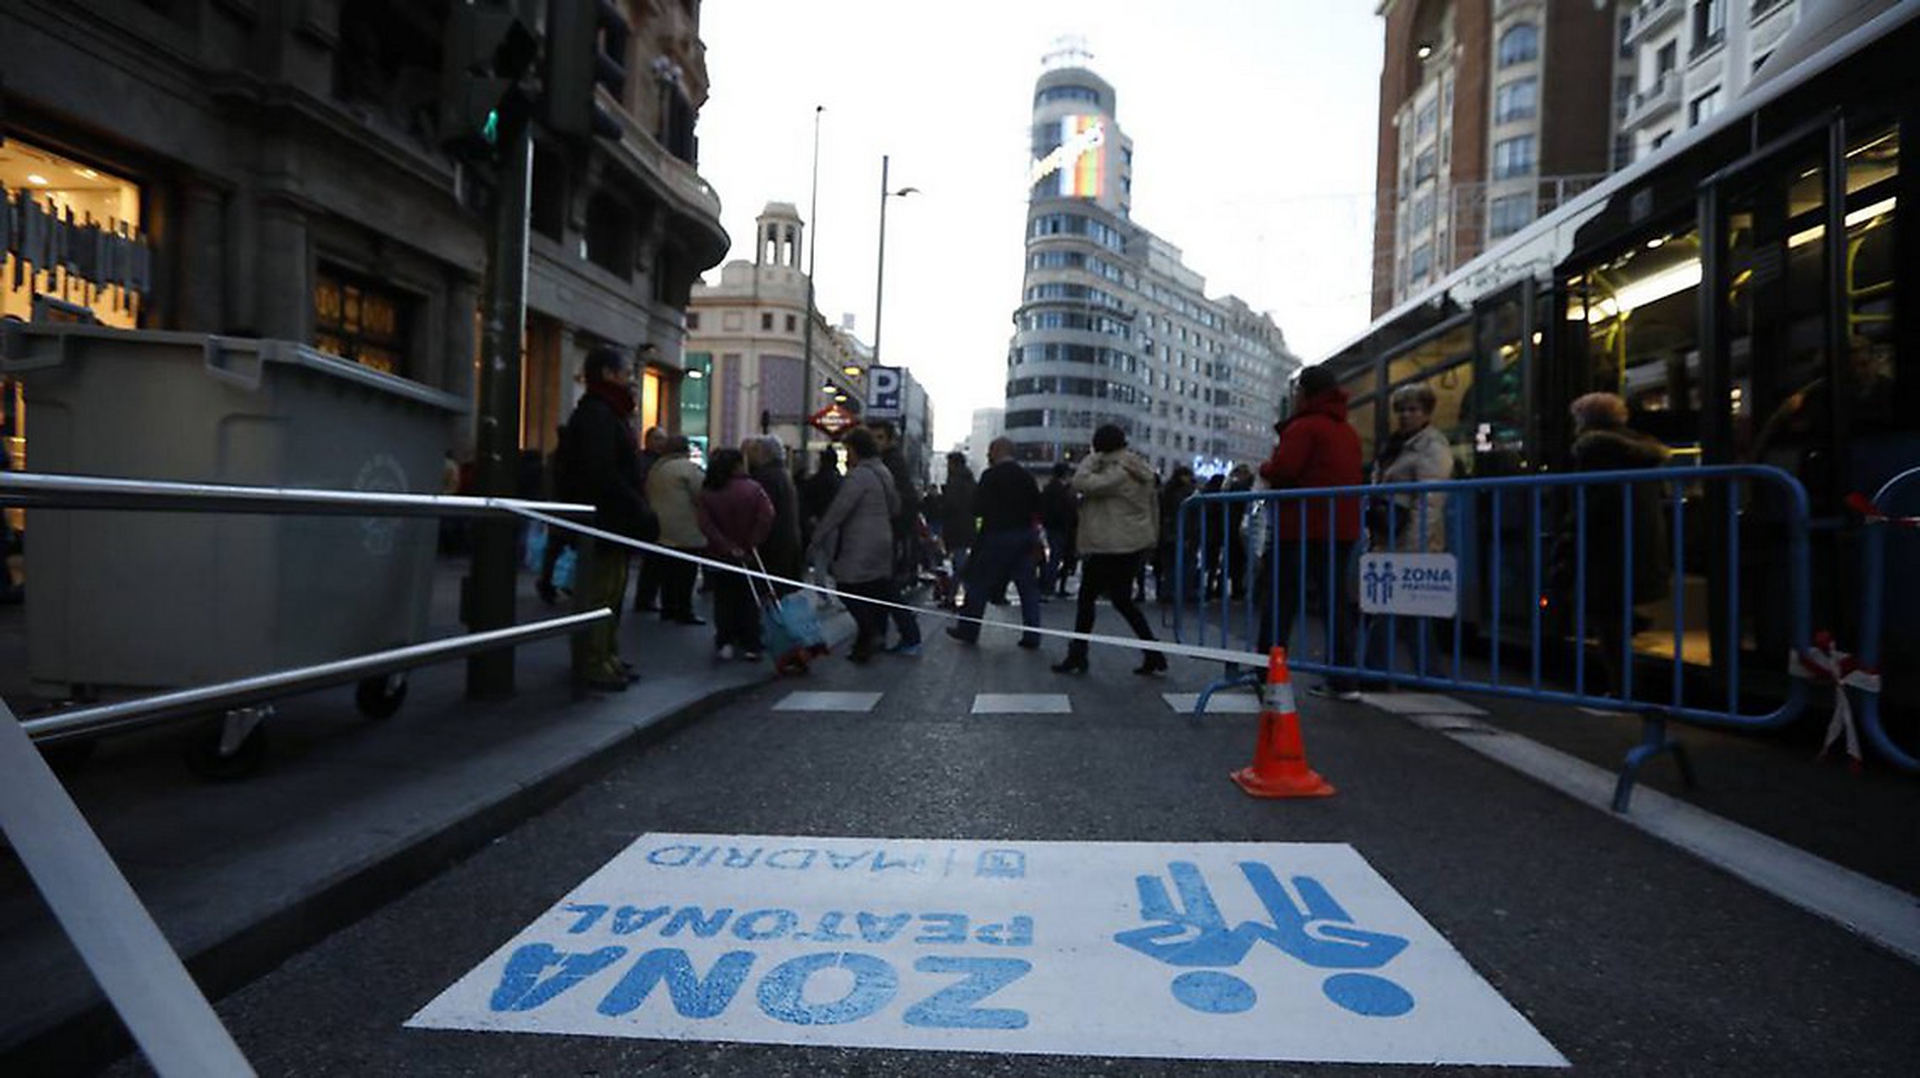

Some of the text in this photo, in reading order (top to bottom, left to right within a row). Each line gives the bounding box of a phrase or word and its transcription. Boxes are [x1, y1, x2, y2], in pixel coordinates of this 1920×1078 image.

[869, 368, 899, 406] P
[1402, 567, 1452, 581] ZONA
[646, 845, 926, 874] MADRID
[564, 903, 1034, 947] PEATONAL
[489, 942, 1034, 1030] ZONA
